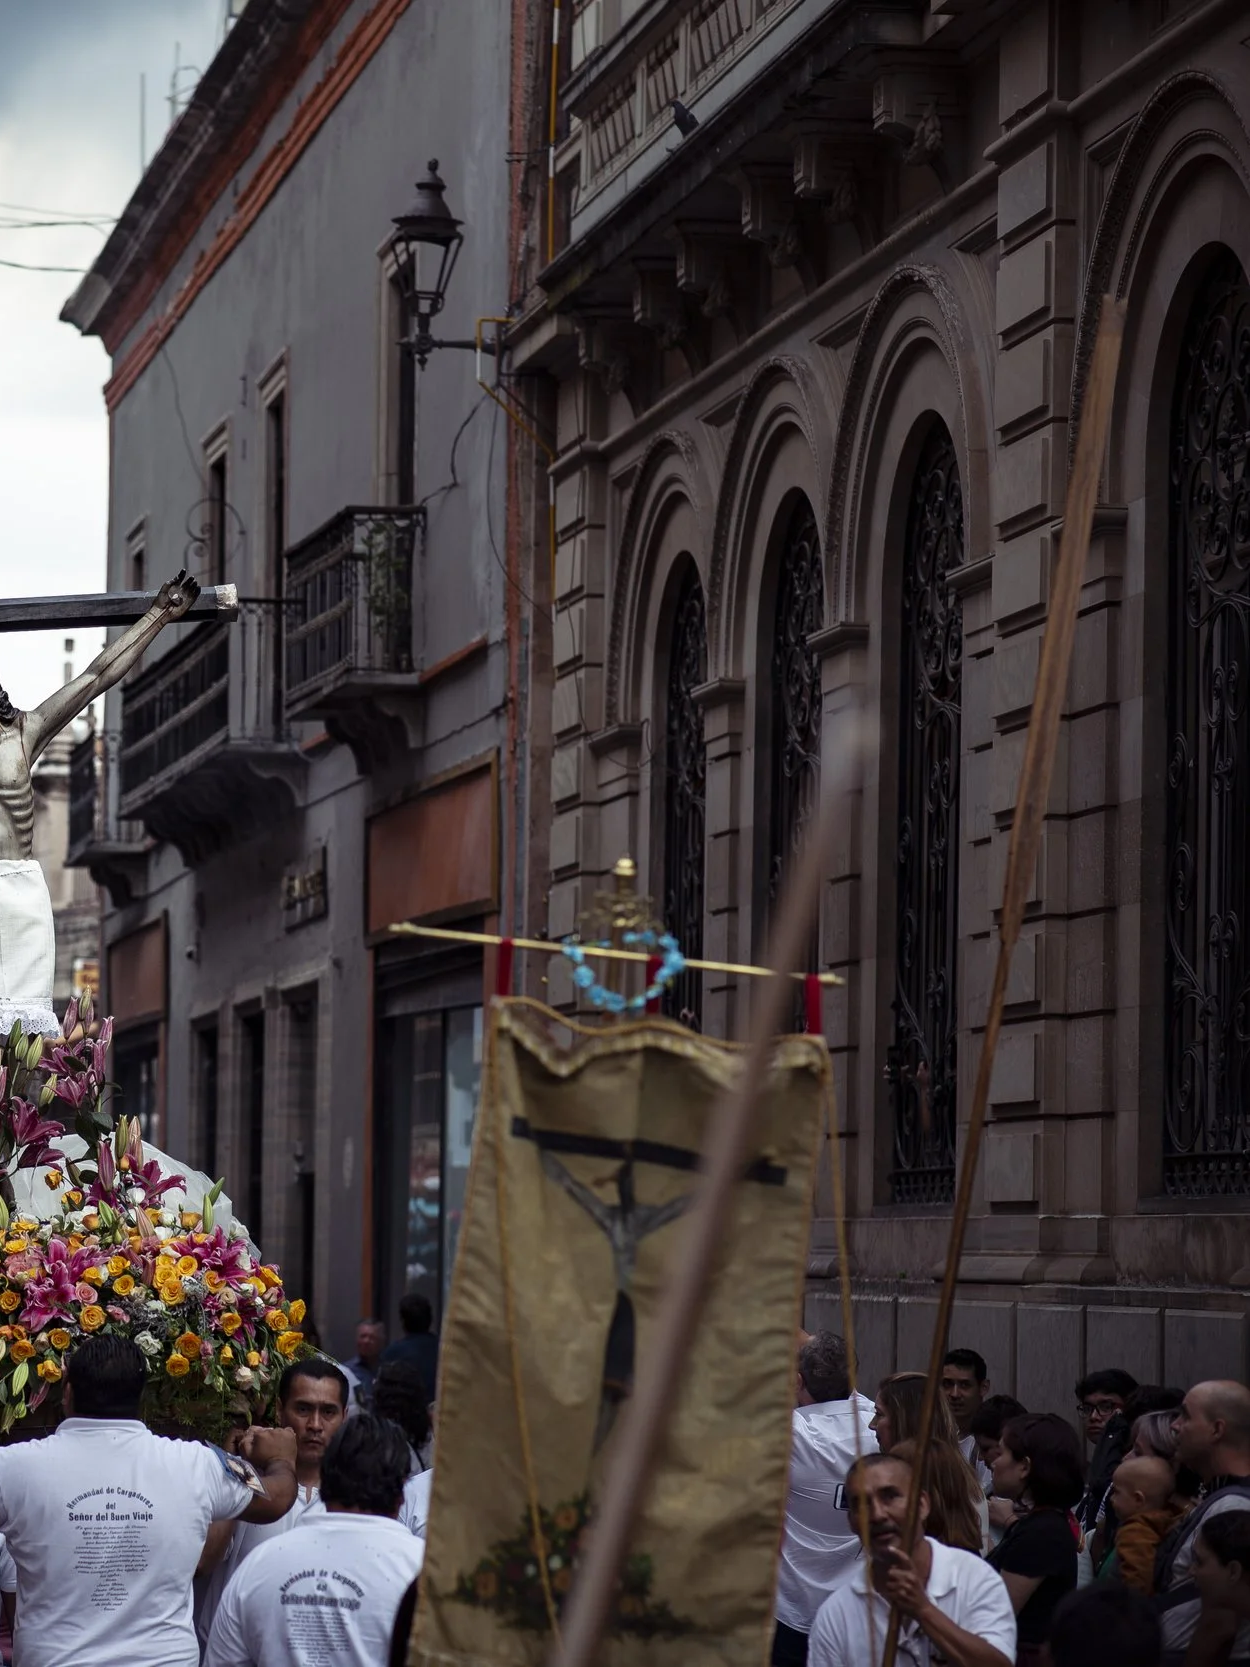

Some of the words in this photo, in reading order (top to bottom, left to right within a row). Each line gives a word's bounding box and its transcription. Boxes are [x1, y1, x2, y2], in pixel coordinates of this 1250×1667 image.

[66, 1487, 104, 1510] Hermandad
[105, 1486, 115, 1494] de
[116, 1486, 154, 1509] Cargadores
[105, 1502, 116, 1510] del
[68, 1512, 93, 1521] Señor
[95, 1512, 109, 1521] del
[110, 1512, 130, 1521] Buen
[132, 1511, 154, 1522] Viaje
